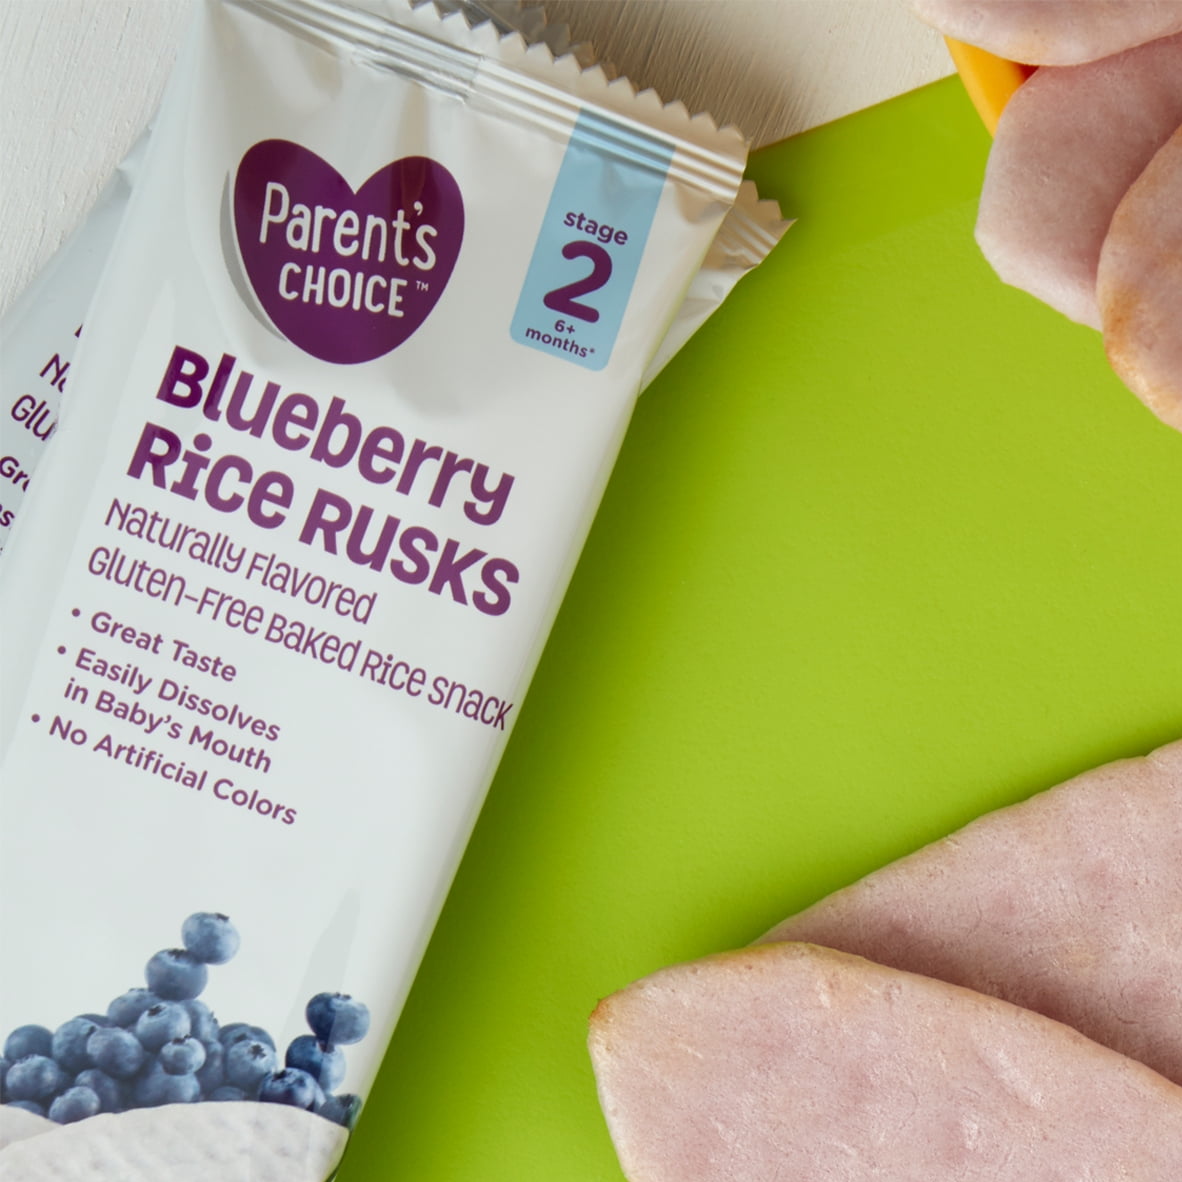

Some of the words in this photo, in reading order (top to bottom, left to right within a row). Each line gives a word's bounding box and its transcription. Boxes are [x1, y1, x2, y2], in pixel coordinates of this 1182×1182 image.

[259, 181, 438, 271] Parent's
[563, 211, 628, 245] stage
[278, 262, 408, 318] CHOICE
[543, 240, 612, 323] 2
[554, 319, 576, 335] 6+
[127, 421, 295, 529] Rice
[155, 345, 515, 526] Blueberry
[104, 498, 247, 574] Naturally
[246, 552, 378, 625] Flavored
[87, 545, 264, 635] Gluten-Free
[359, 649, 427, 697] Rice
[91, 611, 164, 654] Great
[172, 639, 237, 682] Taste
[63, 677, 89, 704] in
[189, 725, 271, 773] Mouth
[75, 647, 152, 695] Easily
[158, 679, 281, 742] Dissolves
[49, 715, 87, 746] No
[93, 735, 208, 792] Artificial
[213, 777, 297, 825] Colors
